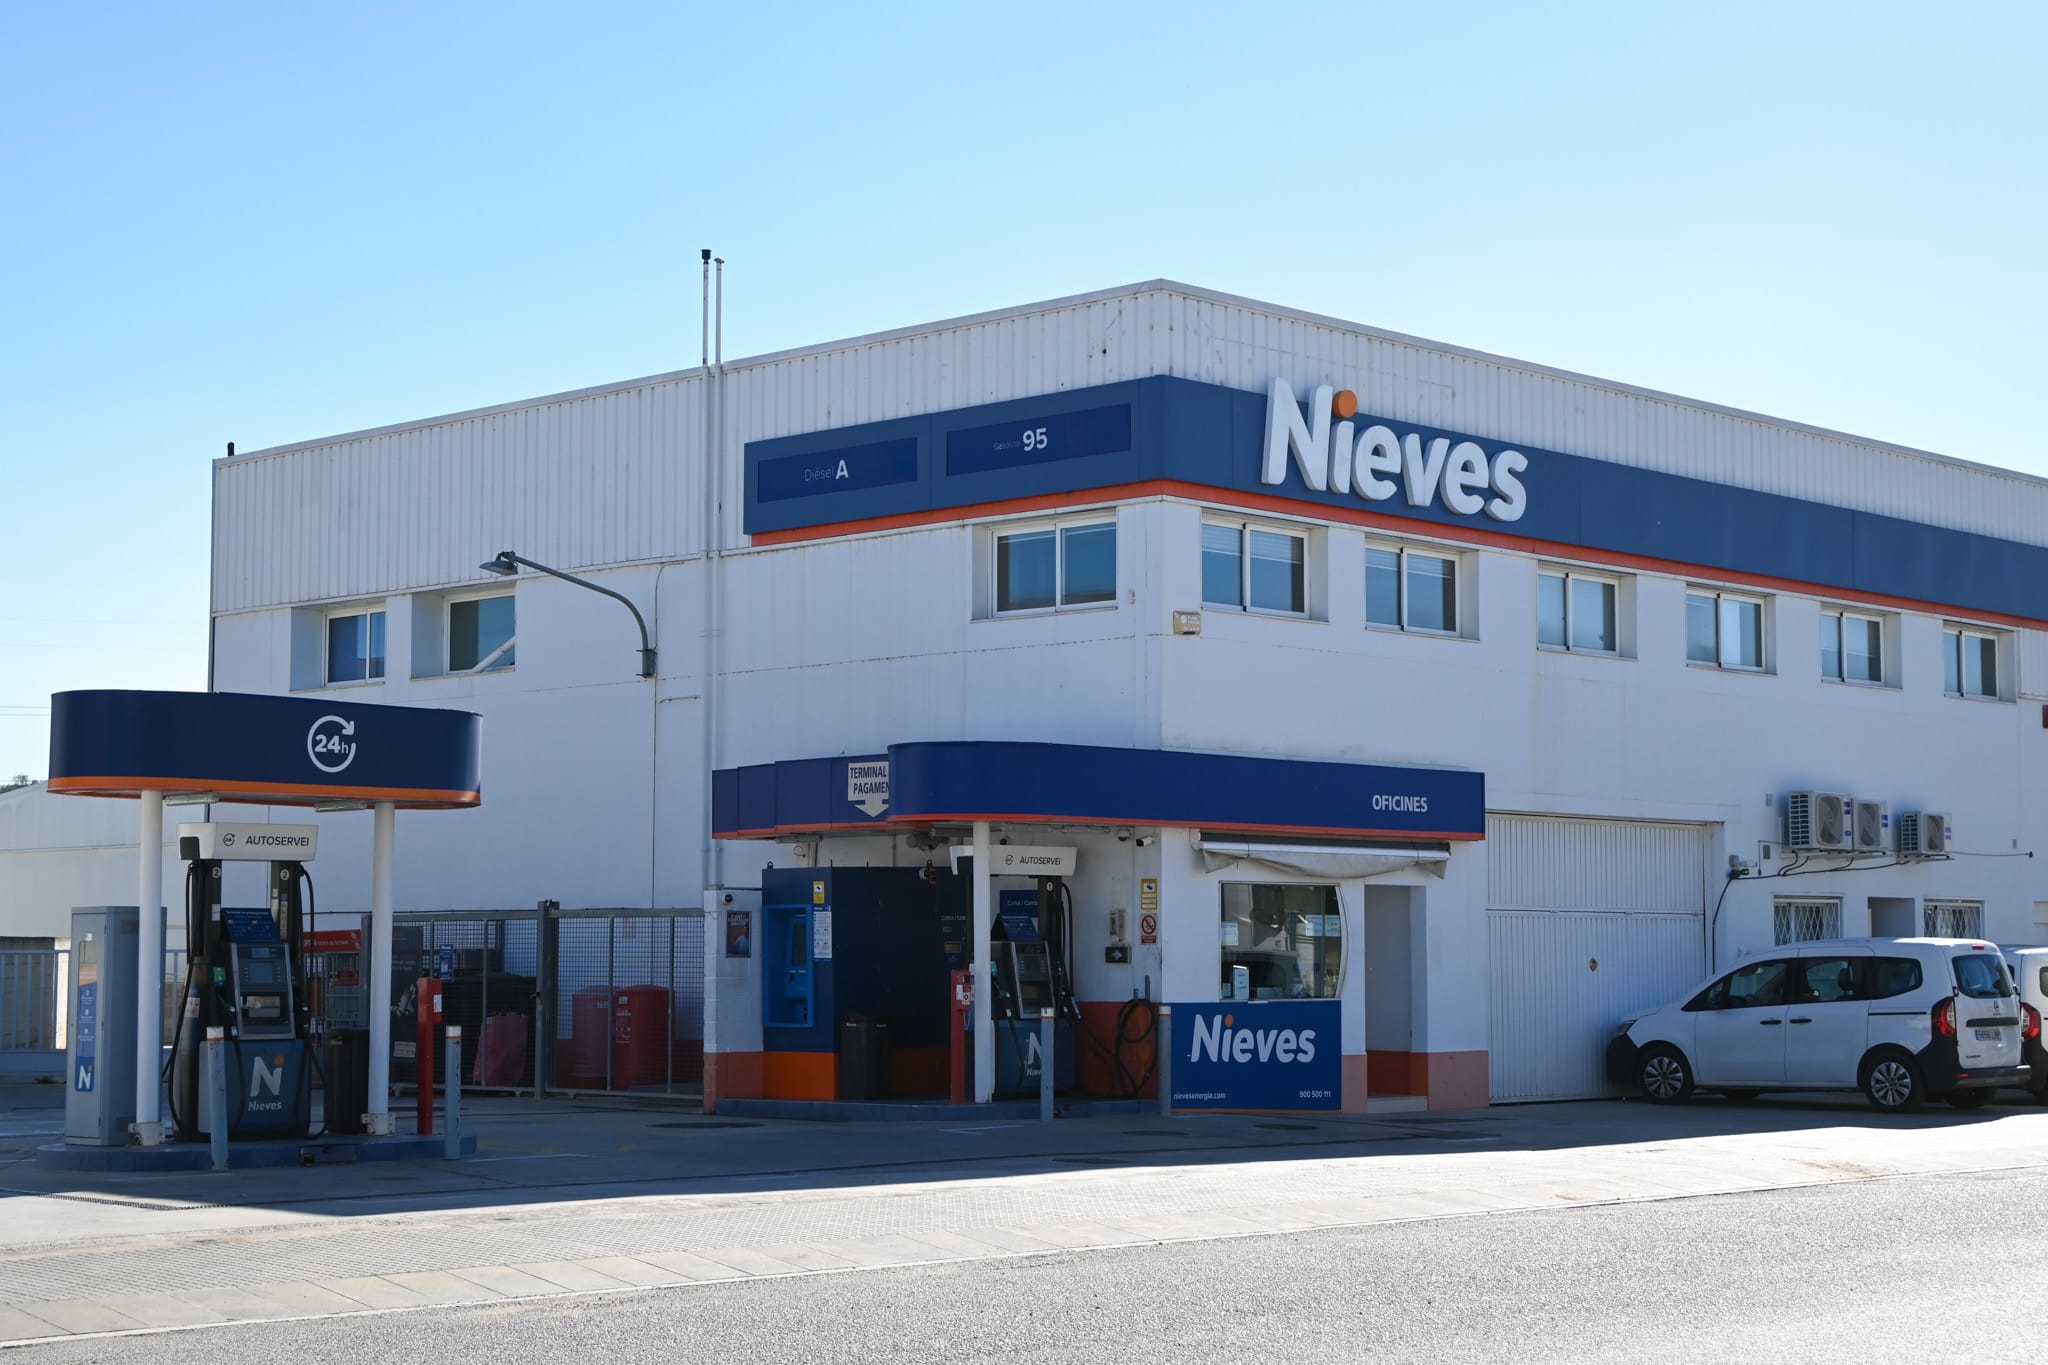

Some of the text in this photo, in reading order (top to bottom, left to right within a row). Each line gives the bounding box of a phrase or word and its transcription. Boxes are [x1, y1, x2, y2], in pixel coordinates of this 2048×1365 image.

[1023, 427, 1048, 451] 95
[1261, 377, 1528, 522] Nieves
[835, 459, 849, 480] A
[314, 734, 349, 754] 24h
[850, 766, 887, 779] TERMINAL
[853, 781, 889, 795] PAGAMEN
[1372, 794, 1428, 812] OFICINES
[245, 835, 309, 847] AUTOSERVEI
[1020, 856, 1061, 865] AUTOSERVEI
[1190, 1014, 1317, 1063] Nieves
[1173, 1091, 1226, 1101] nievesenergia.com
[1299, 1090, 1310, 1098] 900
[1311, 1090, 1322, 1098] 500
[247, 1101, 282, 1112] Nieves
